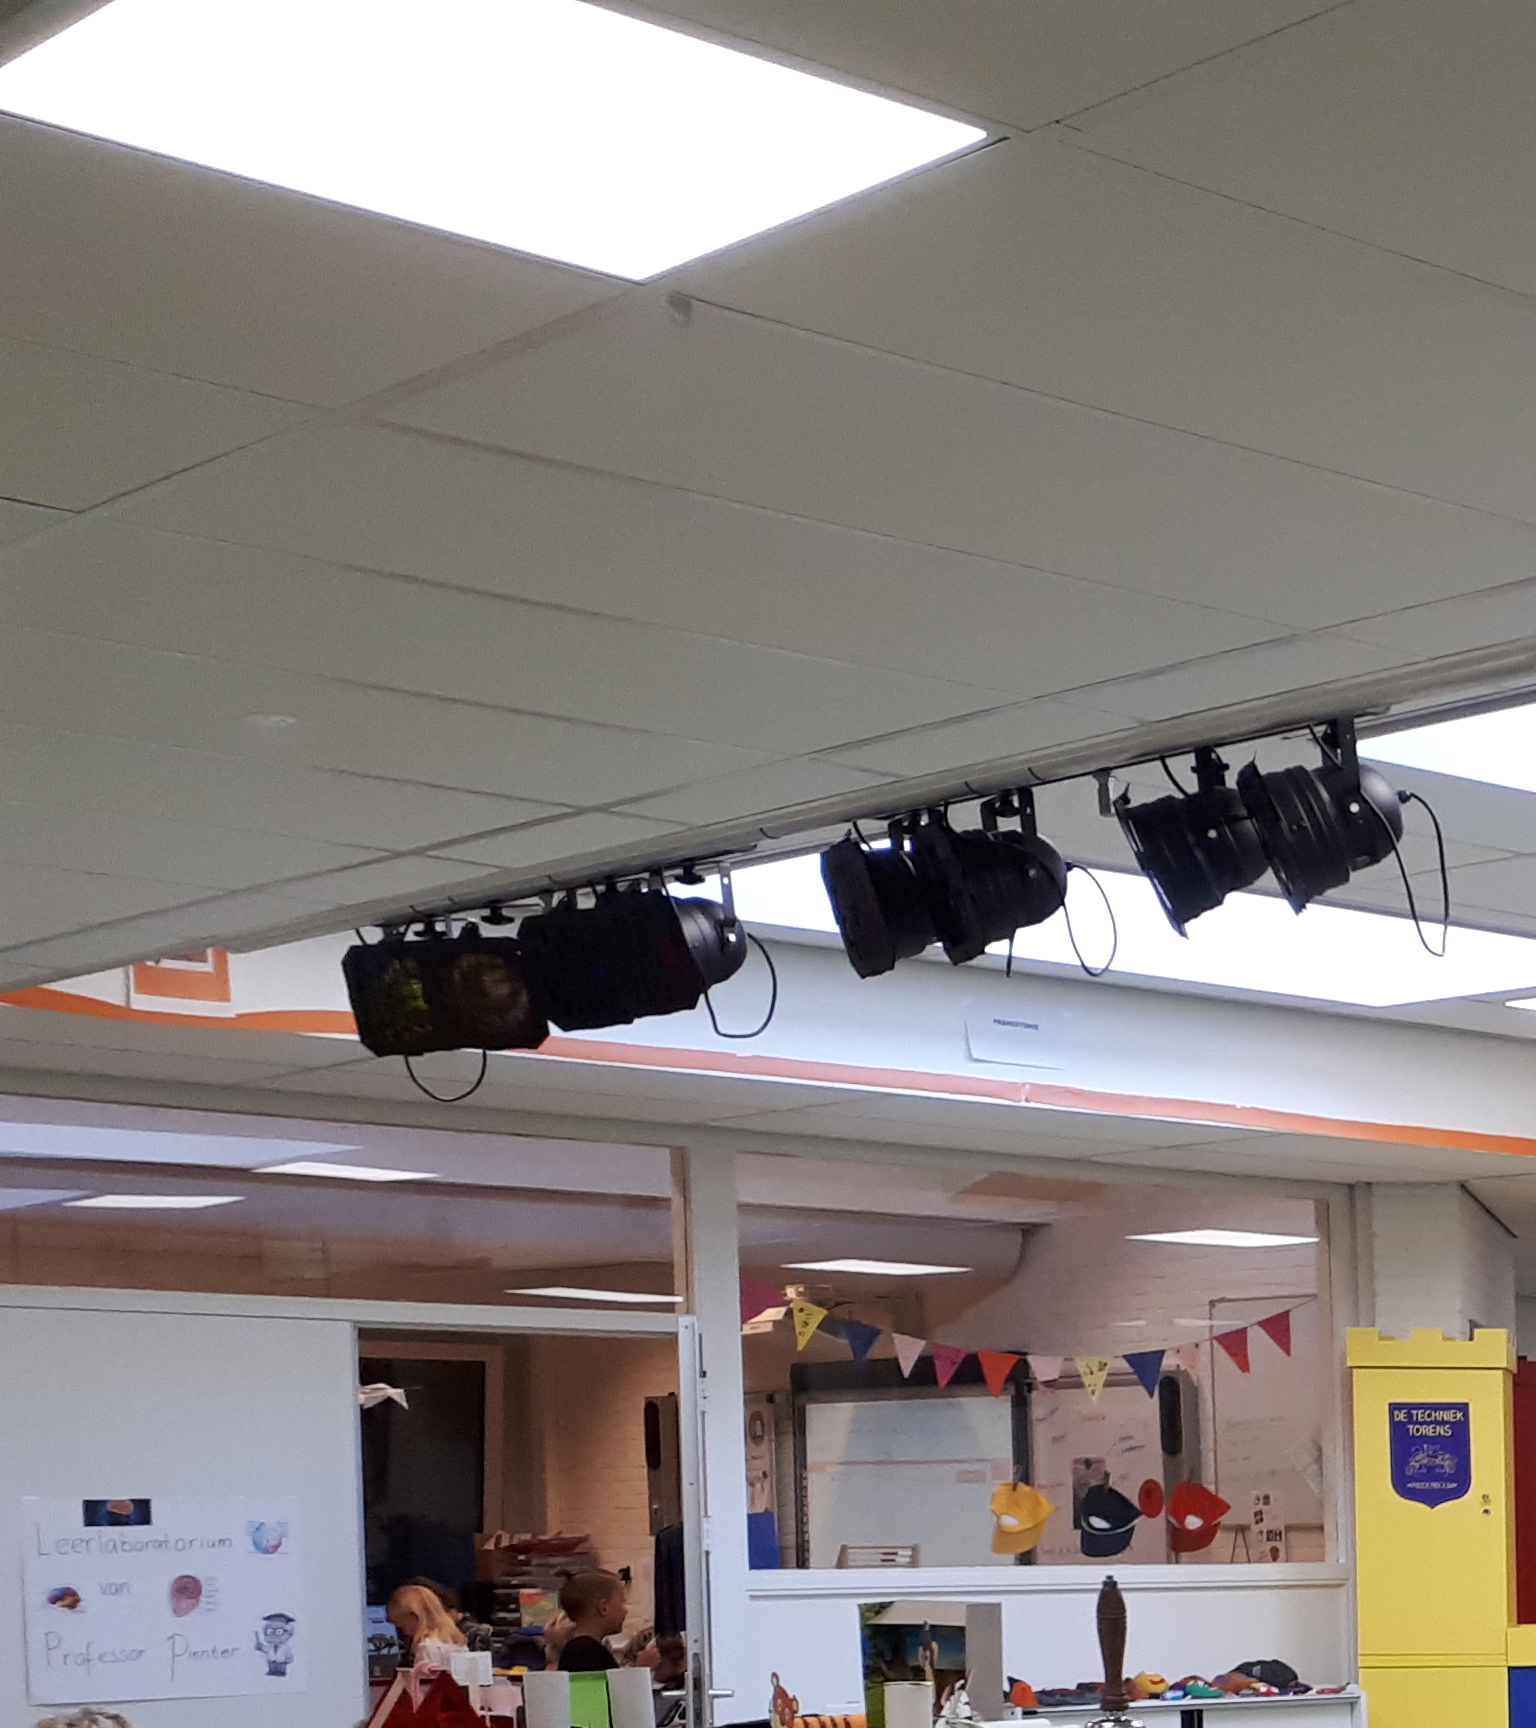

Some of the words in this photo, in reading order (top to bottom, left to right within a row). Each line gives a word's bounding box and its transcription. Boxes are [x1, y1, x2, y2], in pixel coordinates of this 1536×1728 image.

[1393, 1409, 1408, 1422] DE
[1411, 1409, 1465, 1422] TECHNIEK
[1407, 1424, 1453, 1437] TORENS
[36, 1523, 233, 1556] Leerlaboratorium
[98, 1580, 132, 1598] van
[45, 1631, 148, 1676] Professor
